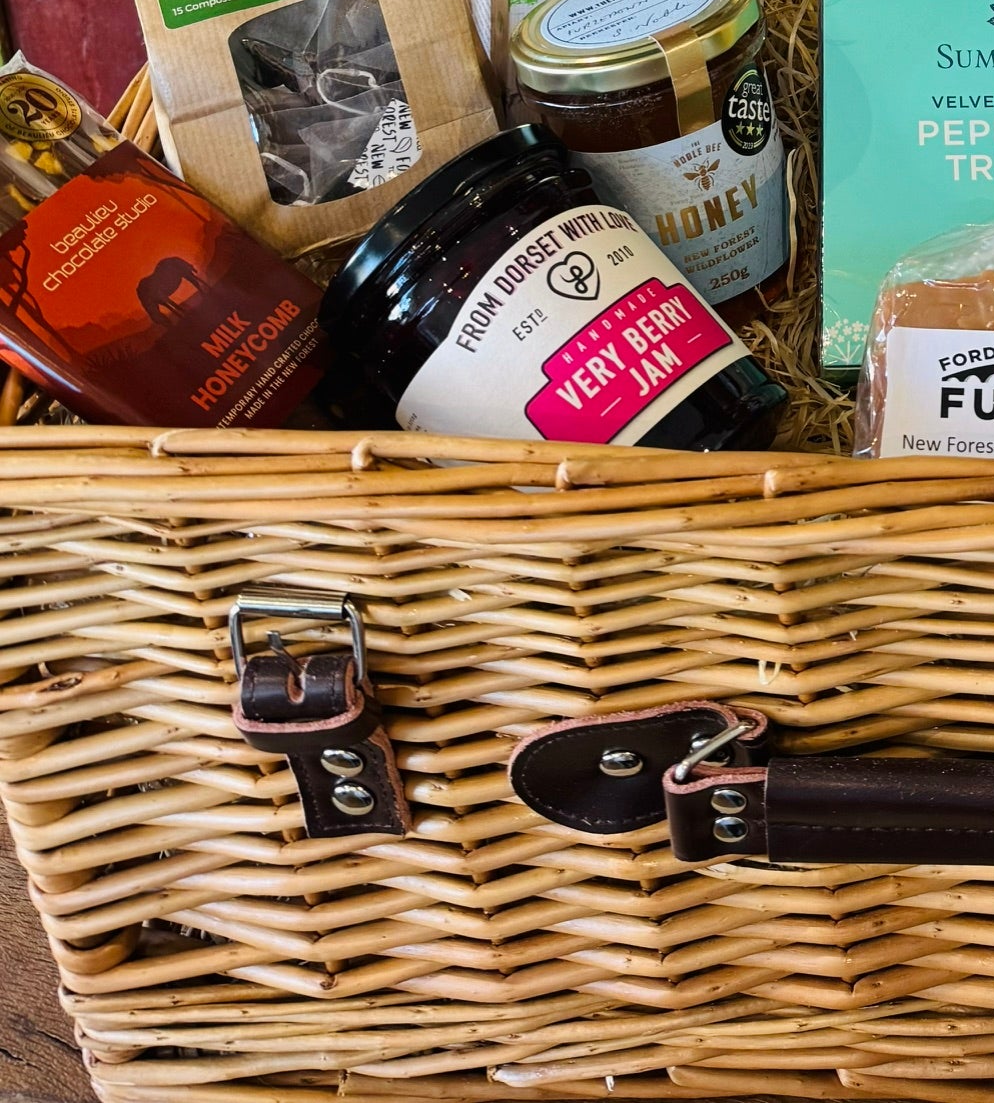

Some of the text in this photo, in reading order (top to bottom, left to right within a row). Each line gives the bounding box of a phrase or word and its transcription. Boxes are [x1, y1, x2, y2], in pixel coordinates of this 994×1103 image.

[7, 88, 58, 127] 20
[728, 95, 771, 123] taste
[742, 81, 764, 97] great
[50, 199, 119, 255] beaulieu
[655, 173, 759, 247] HONEY
[42, 193, 158, 293] chocolate studio
[607, 245, 635, 266] 2010
[684, 226, 756, 264] NEW FOREST
[684, 236, 760, 275] WILDFLOWER
[456, 211, 638, 354] FROM DORSET WITH LOVE
[709, 265, 750, 290] 250g
[190, 299, 301, 412] HONEYCOMB
[200, 310, 252, 359] MILK
[555, 295, 693, 411] VERY BERRY
[244, 397, 266, 420] MADE
[265, 389, 274, 400] IN
[270, 376, 285, 391] THE
[281, 361, 298, 378] NEW
[296, 337, 319, 363] FOREST
[628, 342, 683, 398] JAM
[902, 435, 942, 452] New
